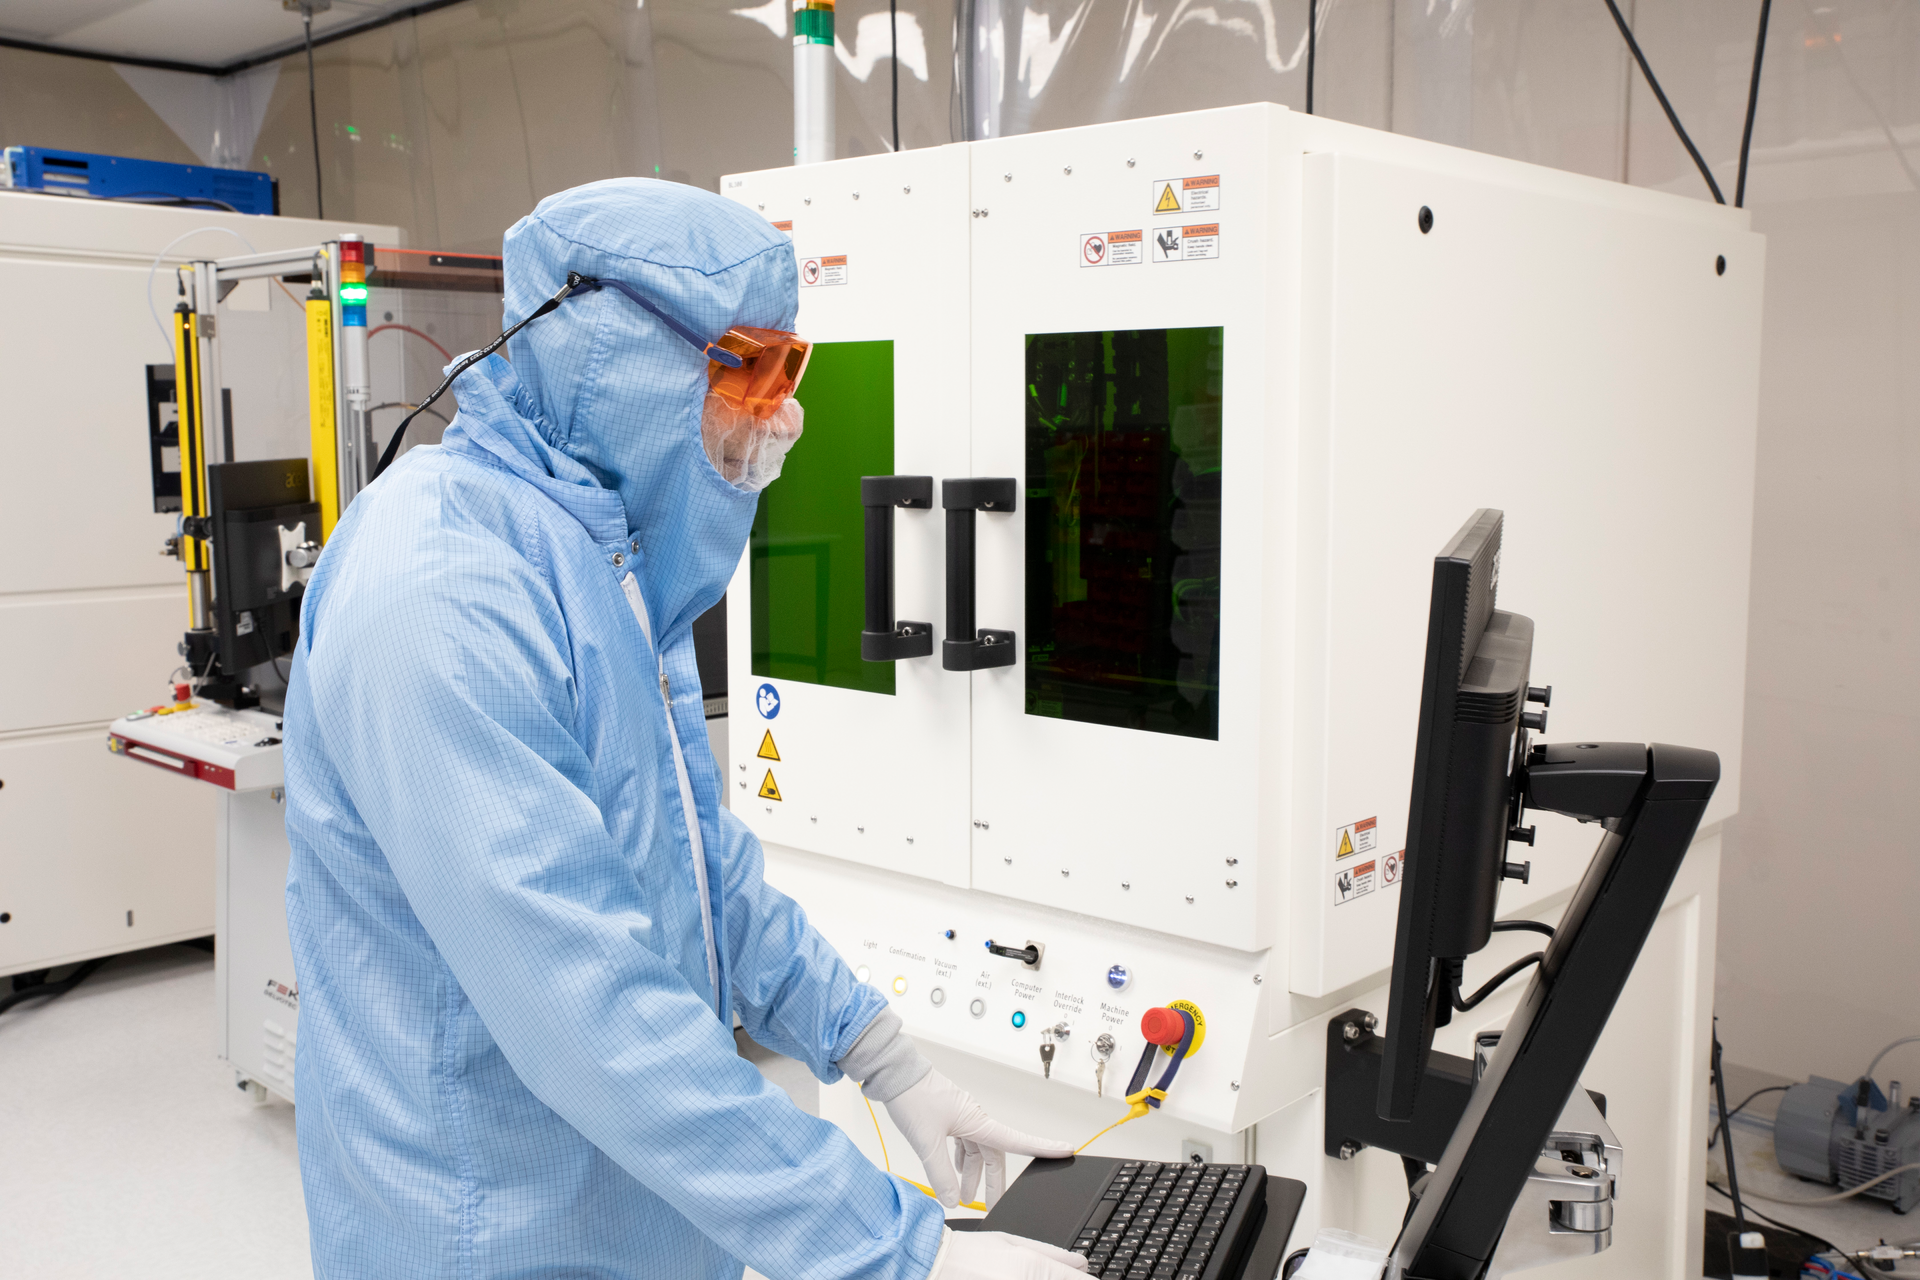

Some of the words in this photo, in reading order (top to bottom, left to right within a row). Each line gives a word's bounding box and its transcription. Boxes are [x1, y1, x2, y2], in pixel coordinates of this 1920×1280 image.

[1190, 178, 1218, 186] WARNING
[1190, 226, 1217, 234] WARNING
[864, 940, 878, 949] Light
[889, 946, 926, 962] Confirmation
[934, 958, 958, 970] Vacuum
[936, 969, 952, 979] (ext.)
[980, 970, 990, 979] Air
[975, 979, 992, 990] (ext.)
[1011, 979, 1043, 993] Computer
[1014, 989, 1035, 1001] Power
[1055, 991, 1084, 1005] Interlock
[1054, 1000, 1082, 1014] Override
[1100, 1002, 1130, 1017] Machine
[1102, 1012, 1124, 1025] Power
